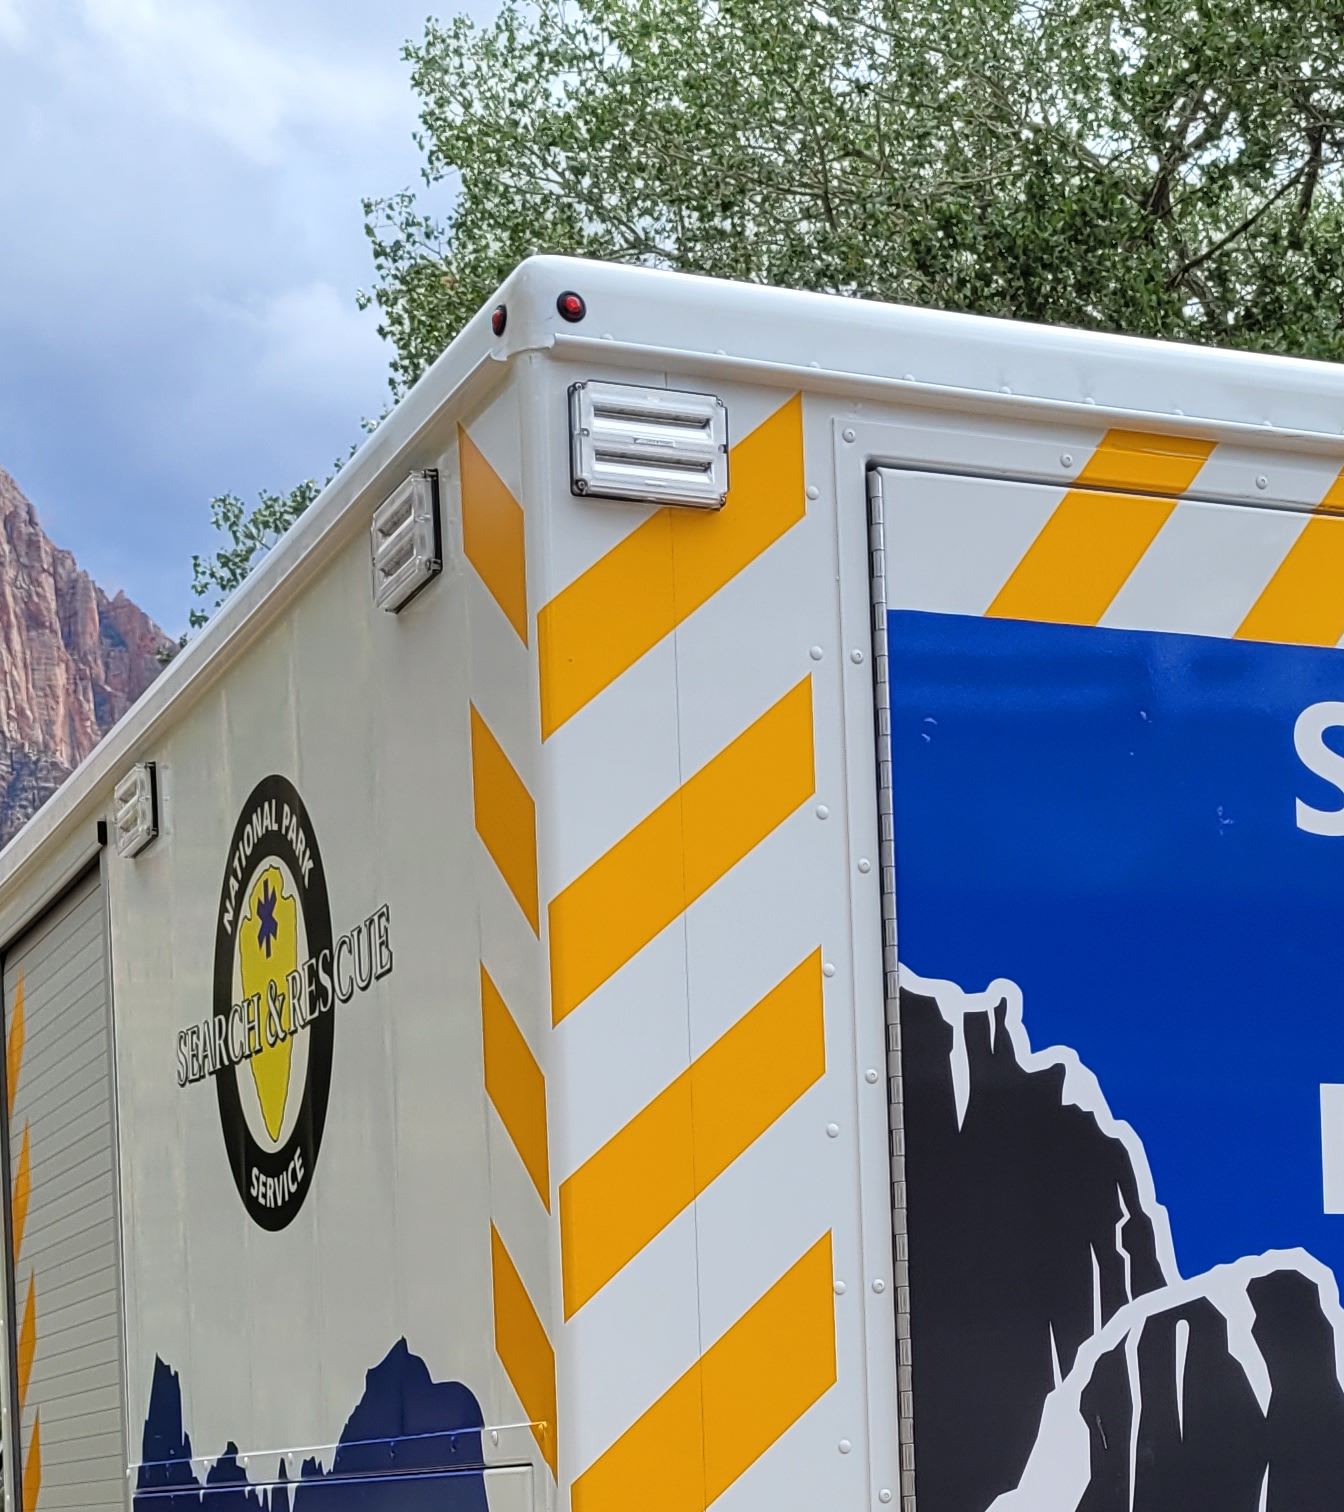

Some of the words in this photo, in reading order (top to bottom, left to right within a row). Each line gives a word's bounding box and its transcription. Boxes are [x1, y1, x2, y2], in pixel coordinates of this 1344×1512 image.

[222, 799, 279, 935] NATIONAL
[281, 803, 314, 889] PARK
[177, 991, 262, 1088] SEARCH
[265, 979, 287, 1047] &
[286, 903, 393, 1035] RESCUE
[250, 1146, 305, 1209] SERVICE
